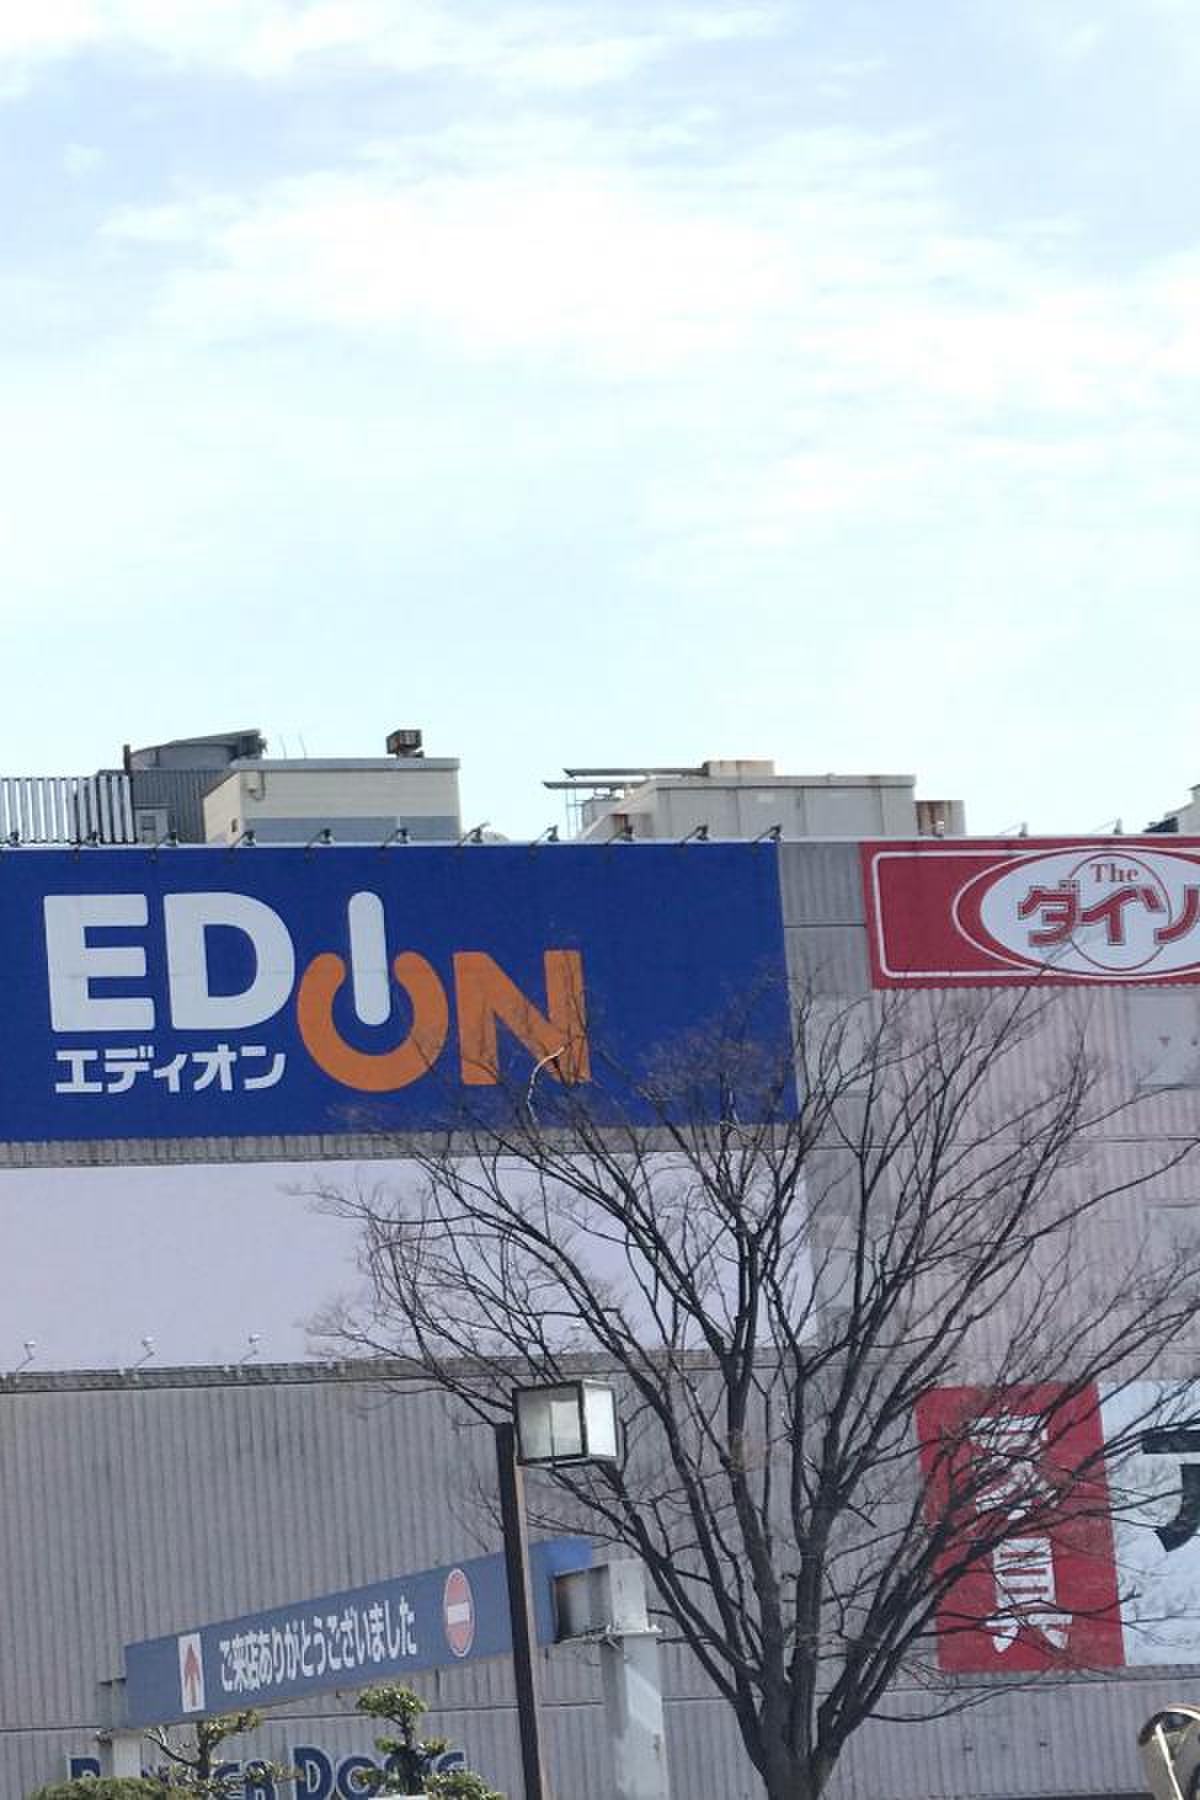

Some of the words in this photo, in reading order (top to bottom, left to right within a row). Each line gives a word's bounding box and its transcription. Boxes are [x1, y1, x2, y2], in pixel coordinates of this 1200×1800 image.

[1089, 863, 1139, 882] The
[43, 891, 593, 1093] EDION
[54, 1044, 287, 1094] エディオン
[219, 1594, 418, 1693] ご来店ありがとうございました
